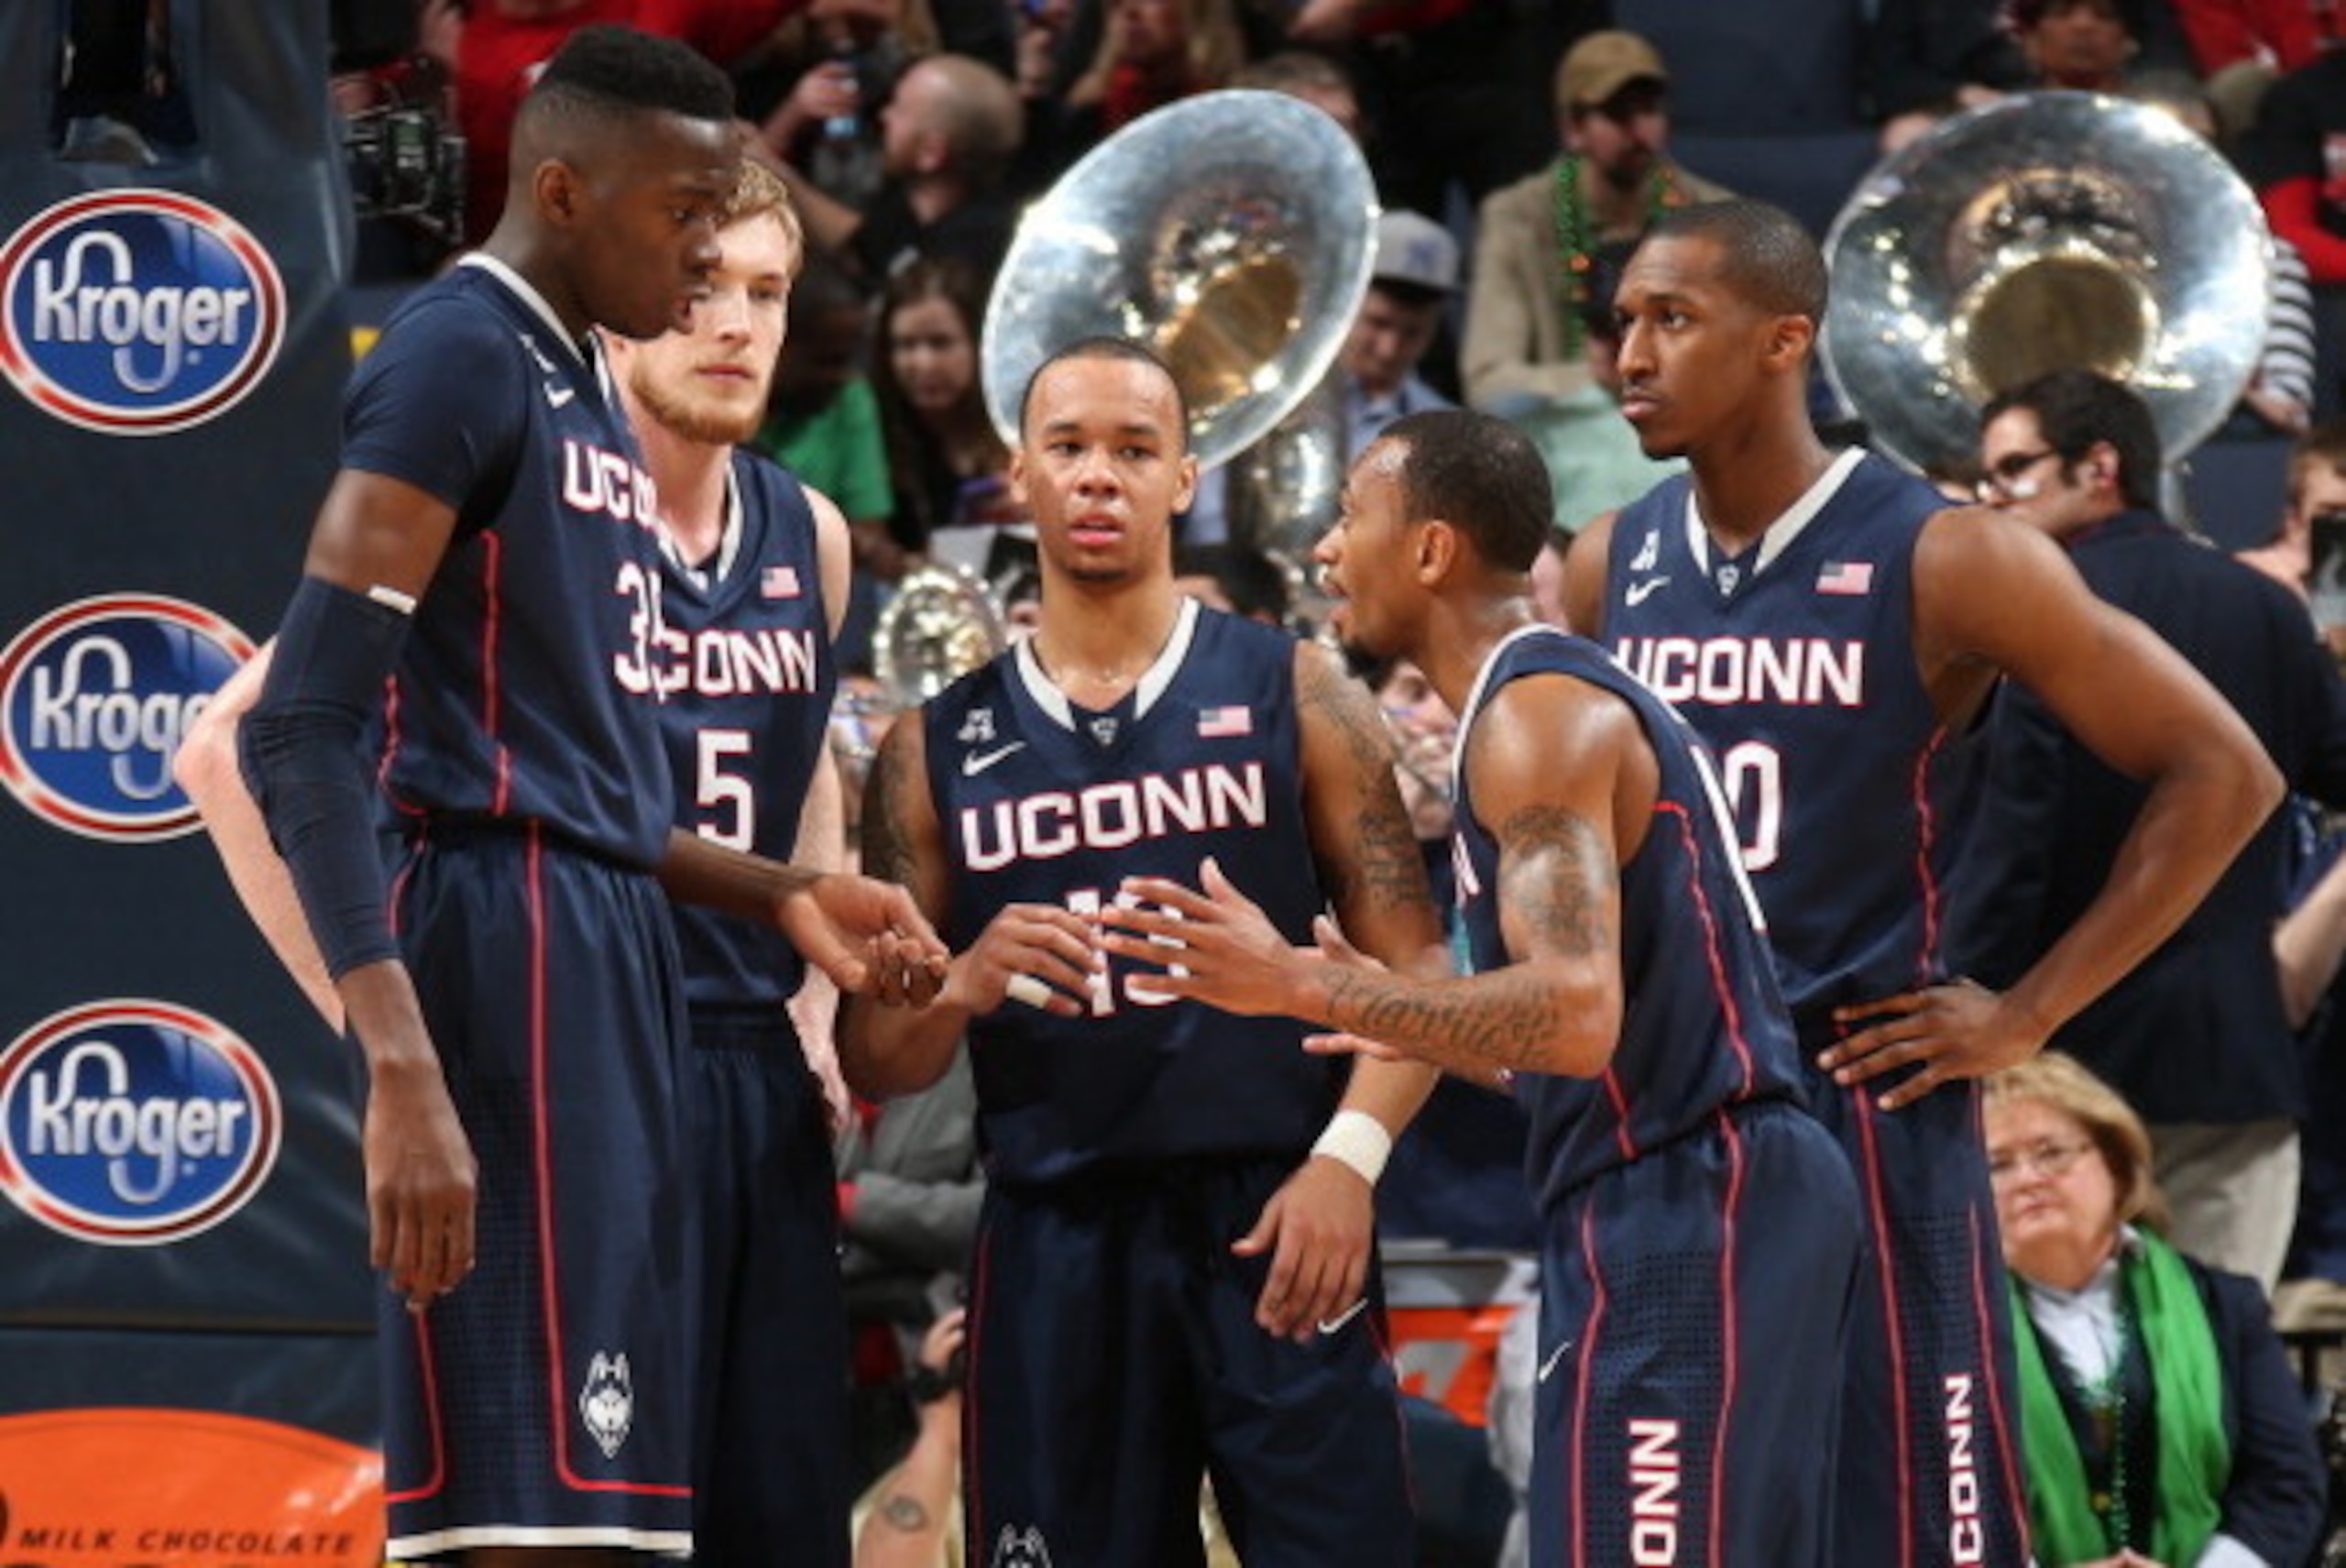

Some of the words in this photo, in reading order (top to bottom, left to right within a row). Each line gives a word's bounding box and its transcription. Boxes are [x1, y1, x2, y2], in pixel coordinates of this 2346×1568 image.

[33, 230, 250, 393] Kroger
[1614, 635, 1866, 707] UCONN
[696, 728, 753, 853] 5
[959, 761, 1268, 872] UCONN
[28, 1041, 246, 1204] Kroger
[18, 1528, 116, 1552] MILK
[137, 1529, 356, 1556] CHOCOLATE
